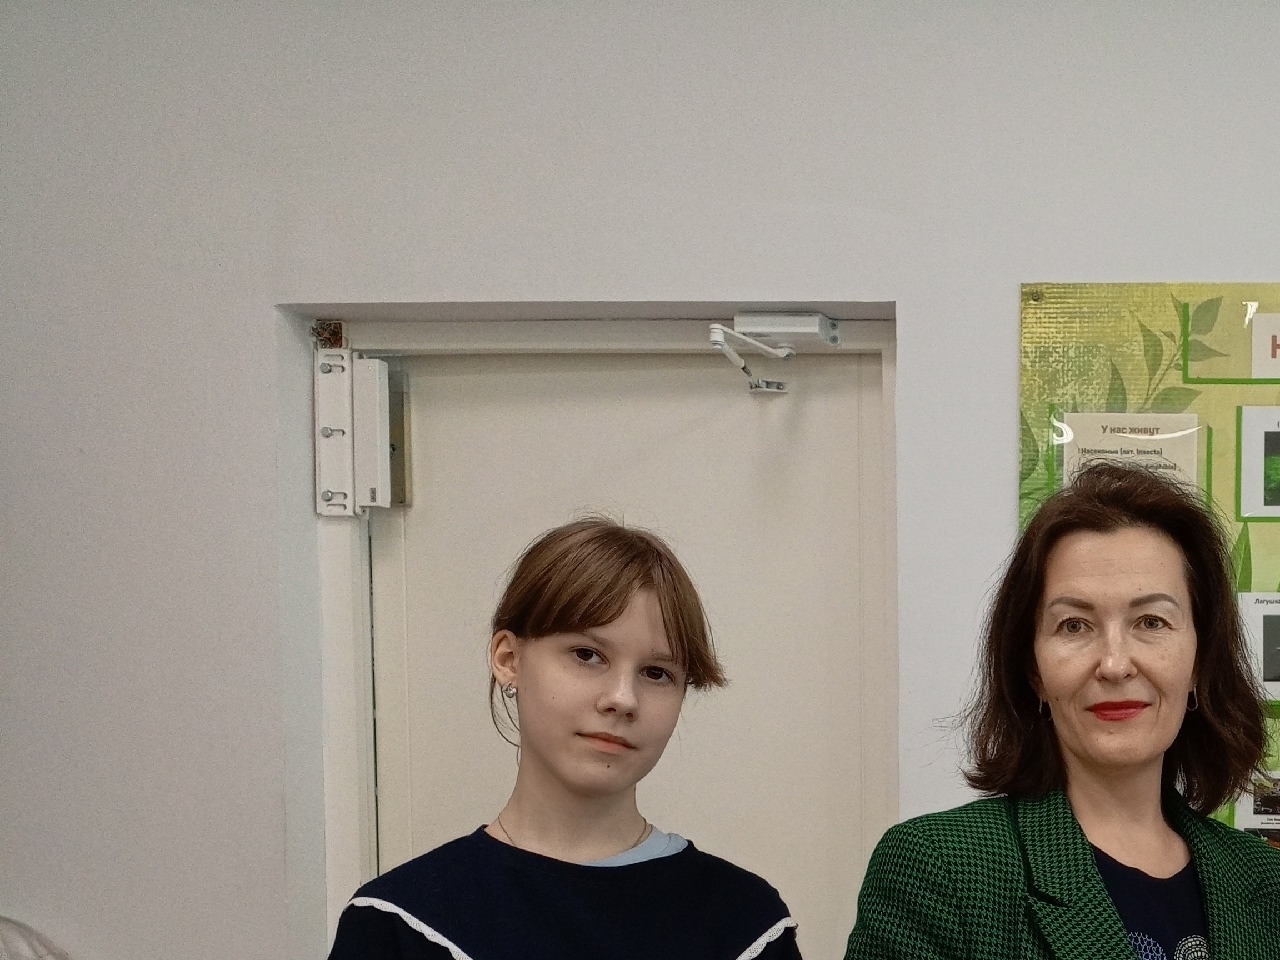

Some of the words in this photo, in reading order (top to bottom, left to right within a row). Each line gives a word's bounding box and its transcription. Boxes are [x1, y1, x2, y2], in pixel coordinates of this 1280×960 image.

[1101, 425, 1109, 434] У
[1110, 427, 1129, 435] нас
[1129, 426, 1160, 437] живут
